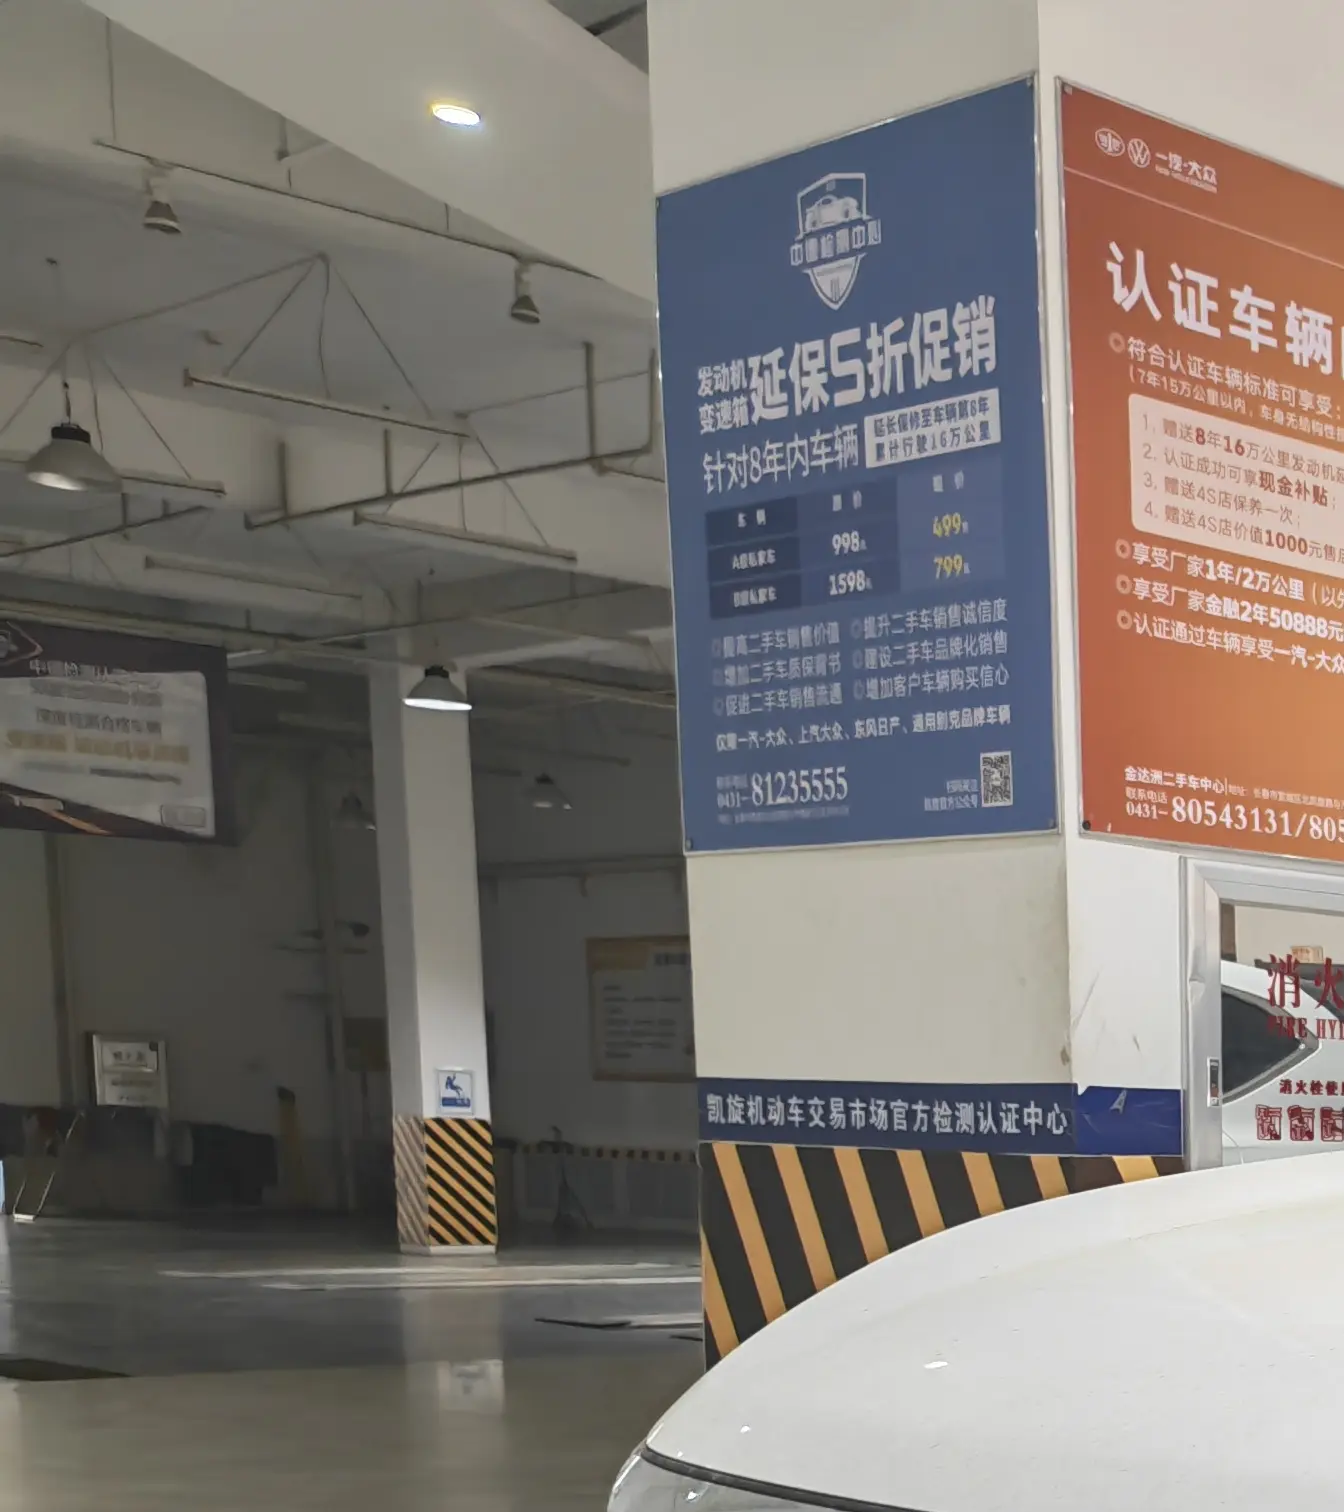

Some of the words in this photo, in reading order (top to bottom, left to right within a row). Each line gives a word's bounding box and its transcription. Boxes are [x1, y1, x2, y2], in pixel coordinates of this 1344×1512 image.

[697, 358, 748, 397] 发动机
[702, 423, 859, 495] 针对8年内车辆
[706, 1093, 1068, 1137] 凯旋机动车交易市场官方检测认证中心
